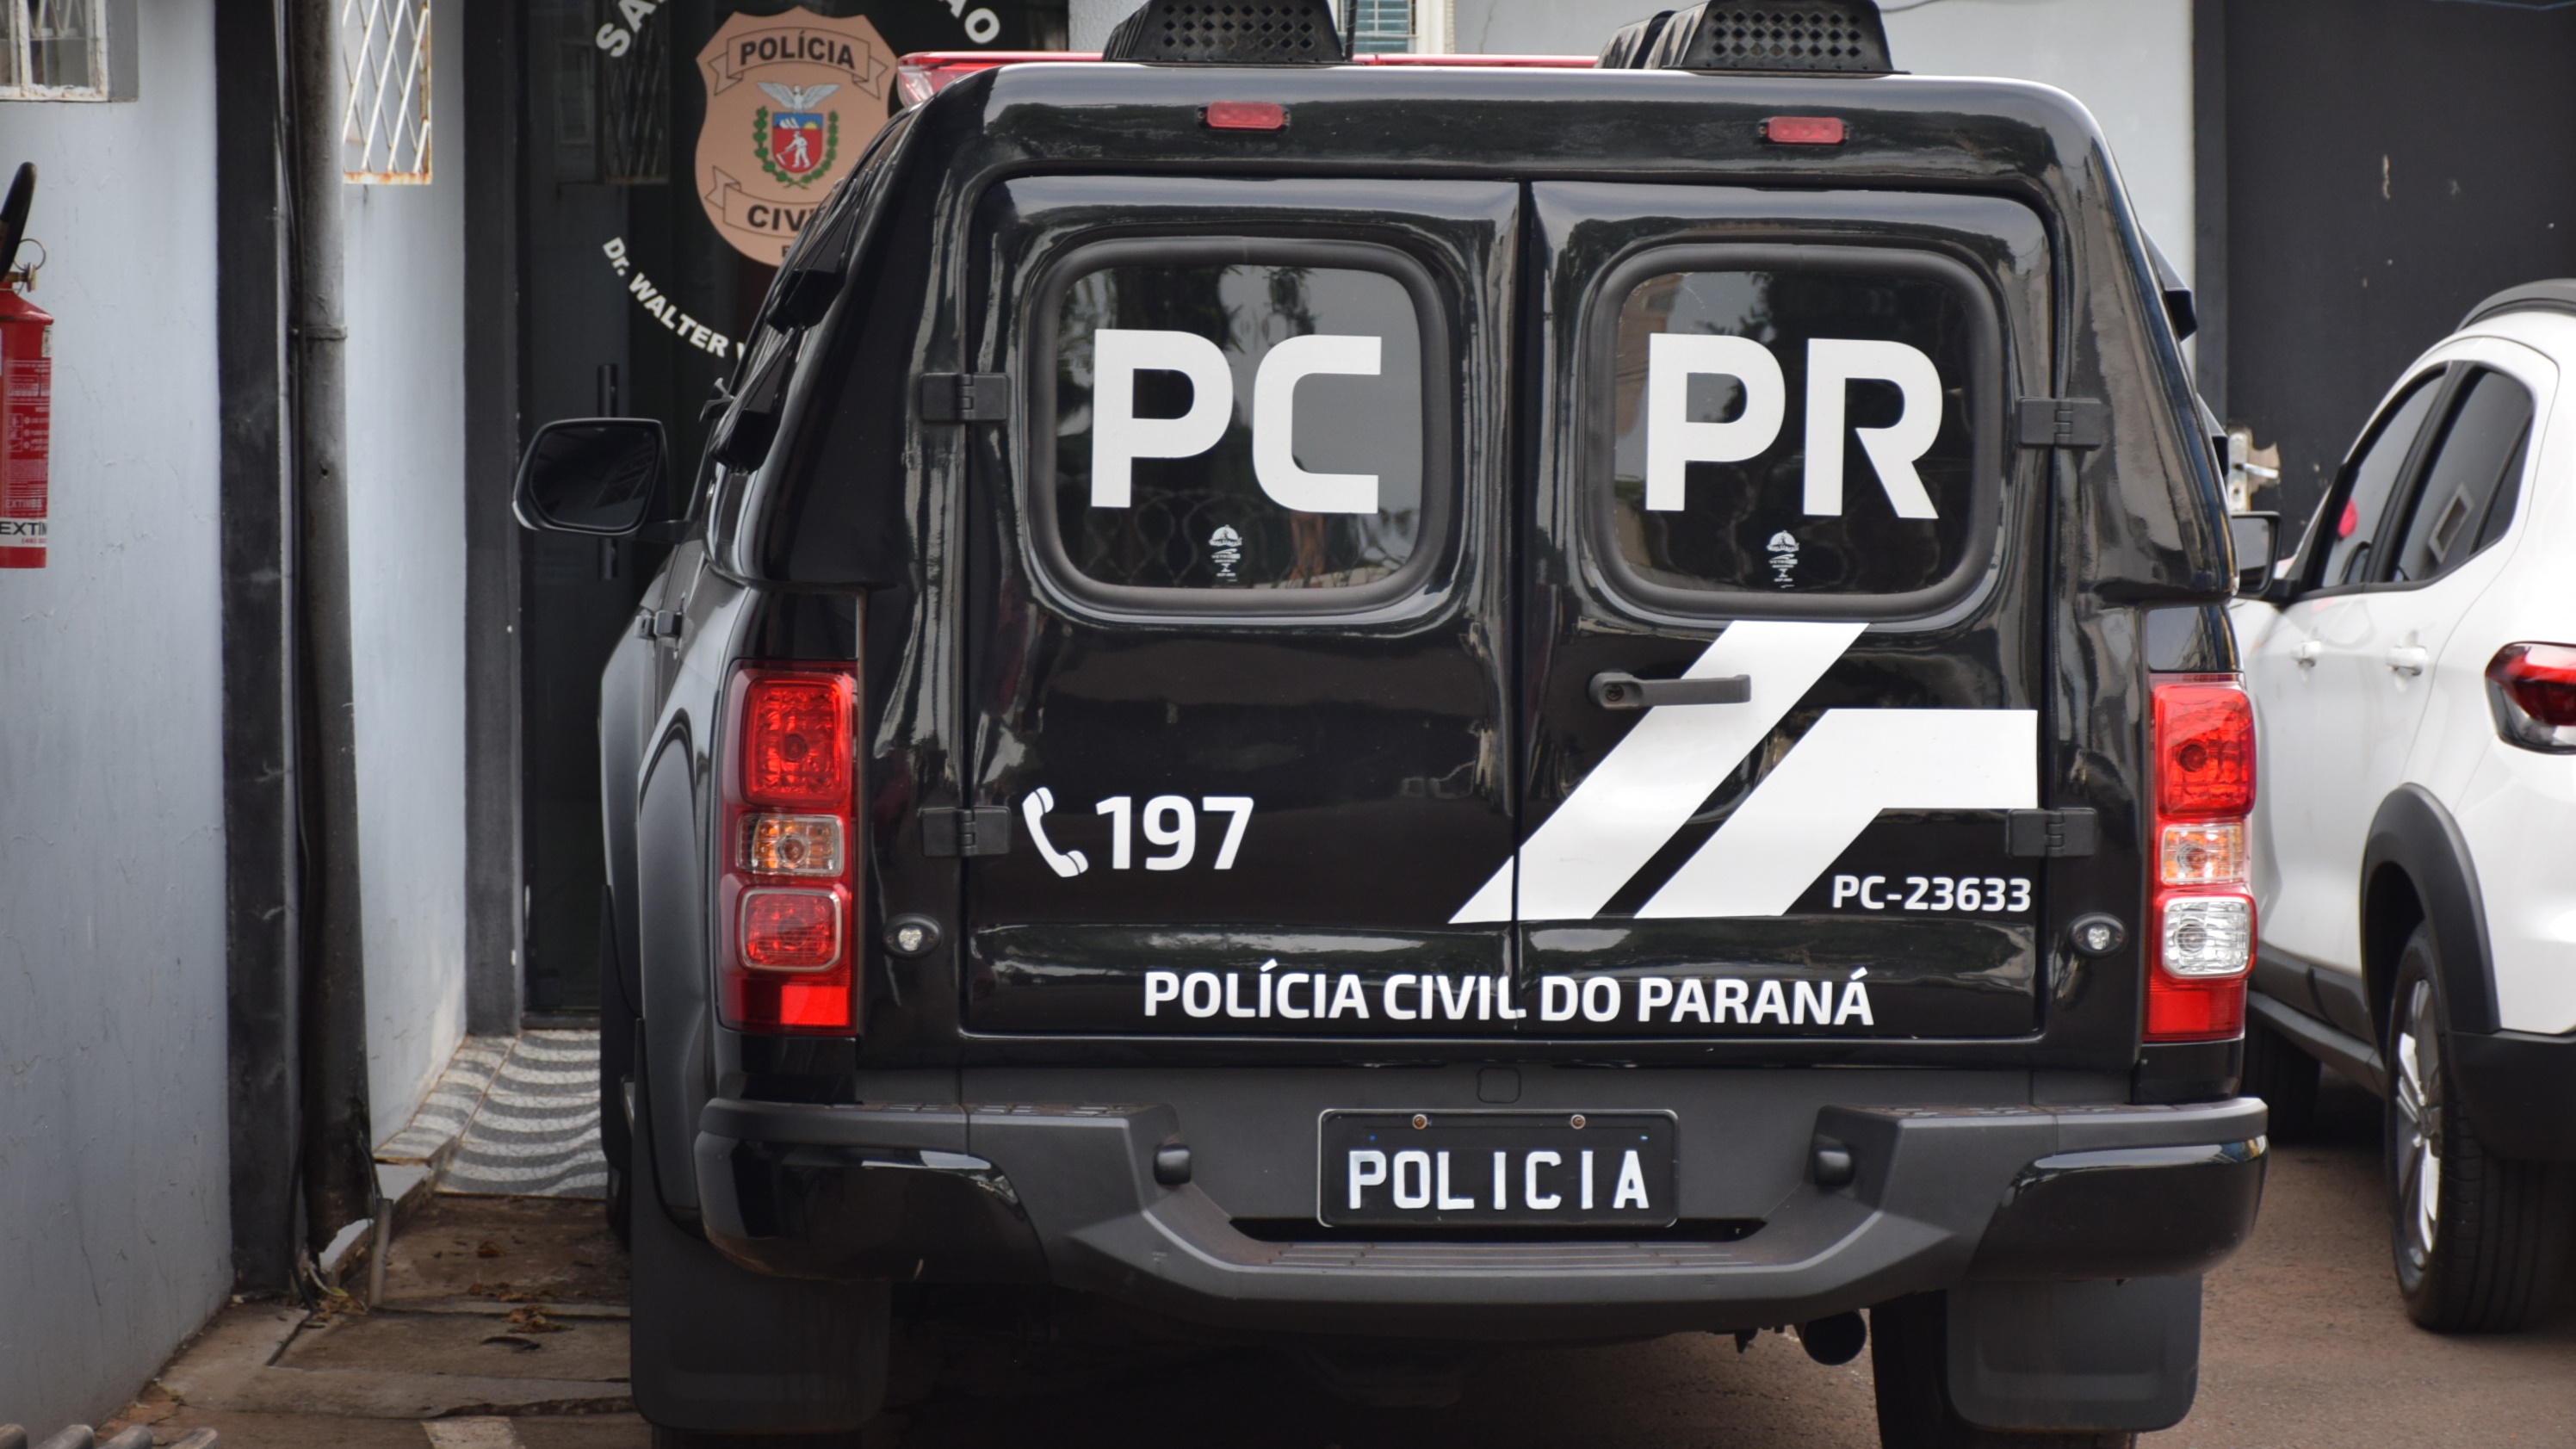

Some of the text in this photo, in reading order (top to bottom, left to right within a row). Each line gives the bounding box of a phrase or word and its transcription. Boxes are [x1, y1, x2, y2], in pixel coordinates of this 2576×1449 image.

[740, 30, 855, 70] POLÍCIA
[746, 204, 817, 232] CIV
[603, 237, 729, 357] Dr. WALTER
[1091, 329, 1942, 519] PC PR
[1094, 795, 1255, 871] 197
[1832, 875, 2032, 913] PC-23633
[1144, 959, 1875, 1025] POLÍCIA CIVIL DO PARANÁ
[1347, 1149, 1650, 1211] POLICIA
